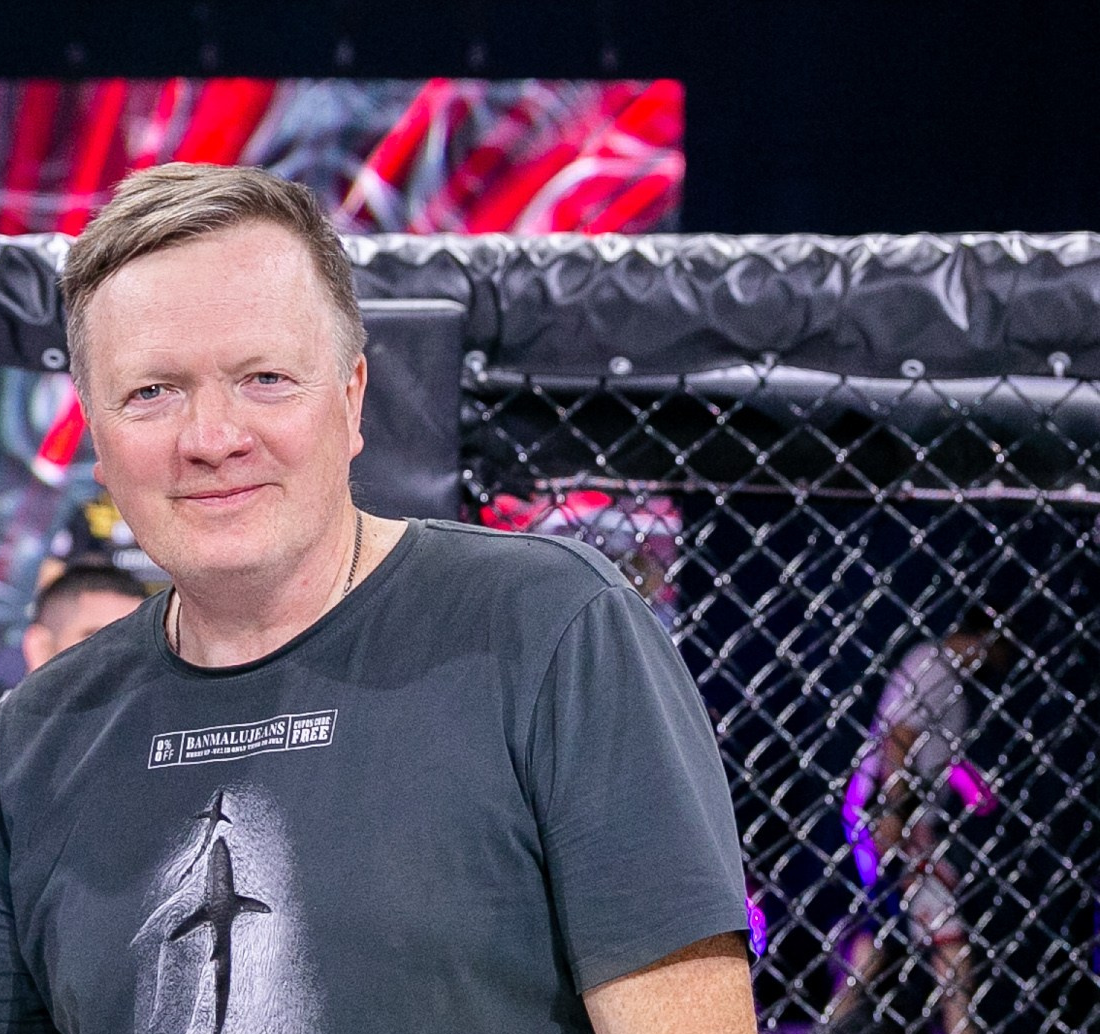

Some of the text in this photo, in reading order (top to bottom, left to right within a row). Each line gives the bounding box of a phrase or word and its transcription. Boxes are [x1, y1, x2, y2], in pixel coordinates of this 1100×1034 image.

[186, 721, 285, 750] BANMALUJEANS
[291, 726, 329, 744] FREE
[156, 739, 172, 750] 0%
[154, 749, 174, 762] OFF
